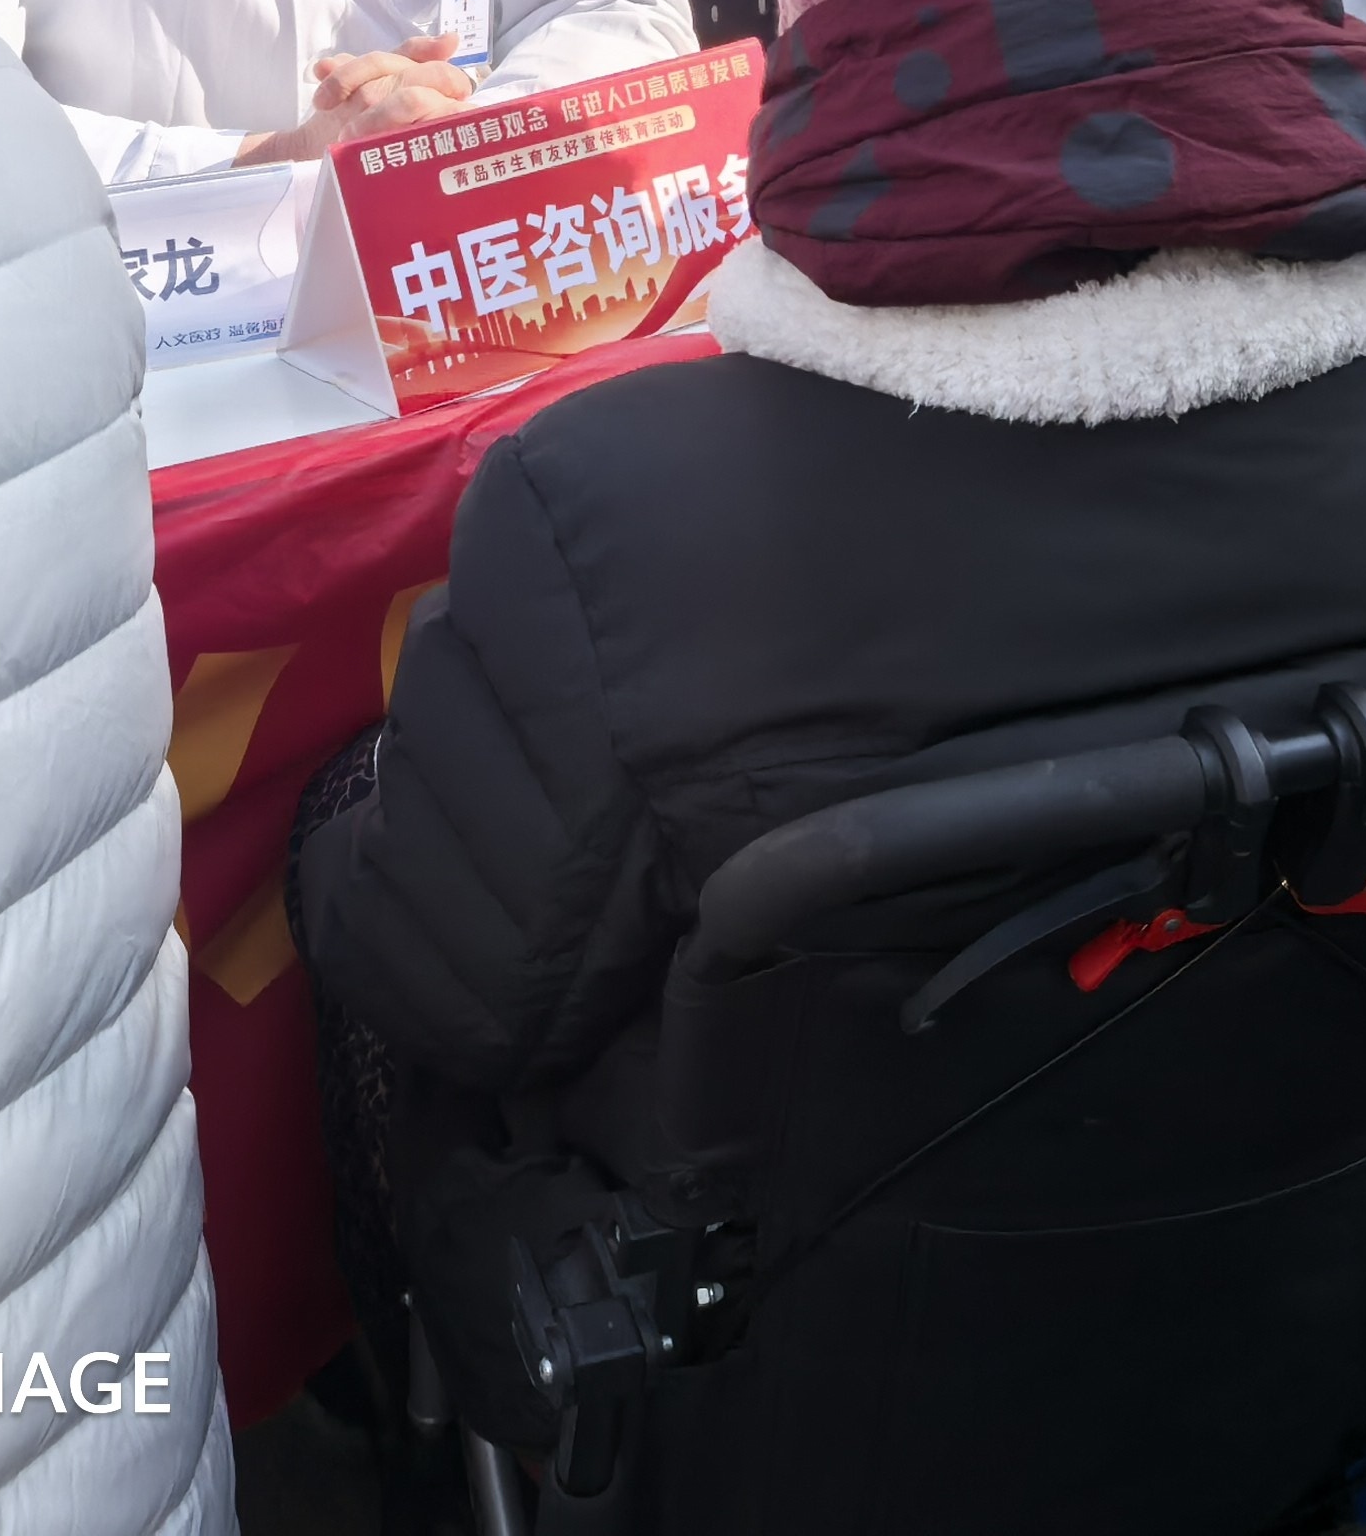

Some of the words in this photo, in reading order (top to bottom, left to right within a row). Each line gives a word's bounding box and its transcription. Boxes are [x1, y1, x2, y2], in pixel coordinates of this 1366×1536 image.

[360, 107, 549, 176] 倡导积极婚育观念
[561, 54, 752, 123] 促进人口高质量发展
[451, 108, 684, 188] 青岛市生育友好宣传教育活动
